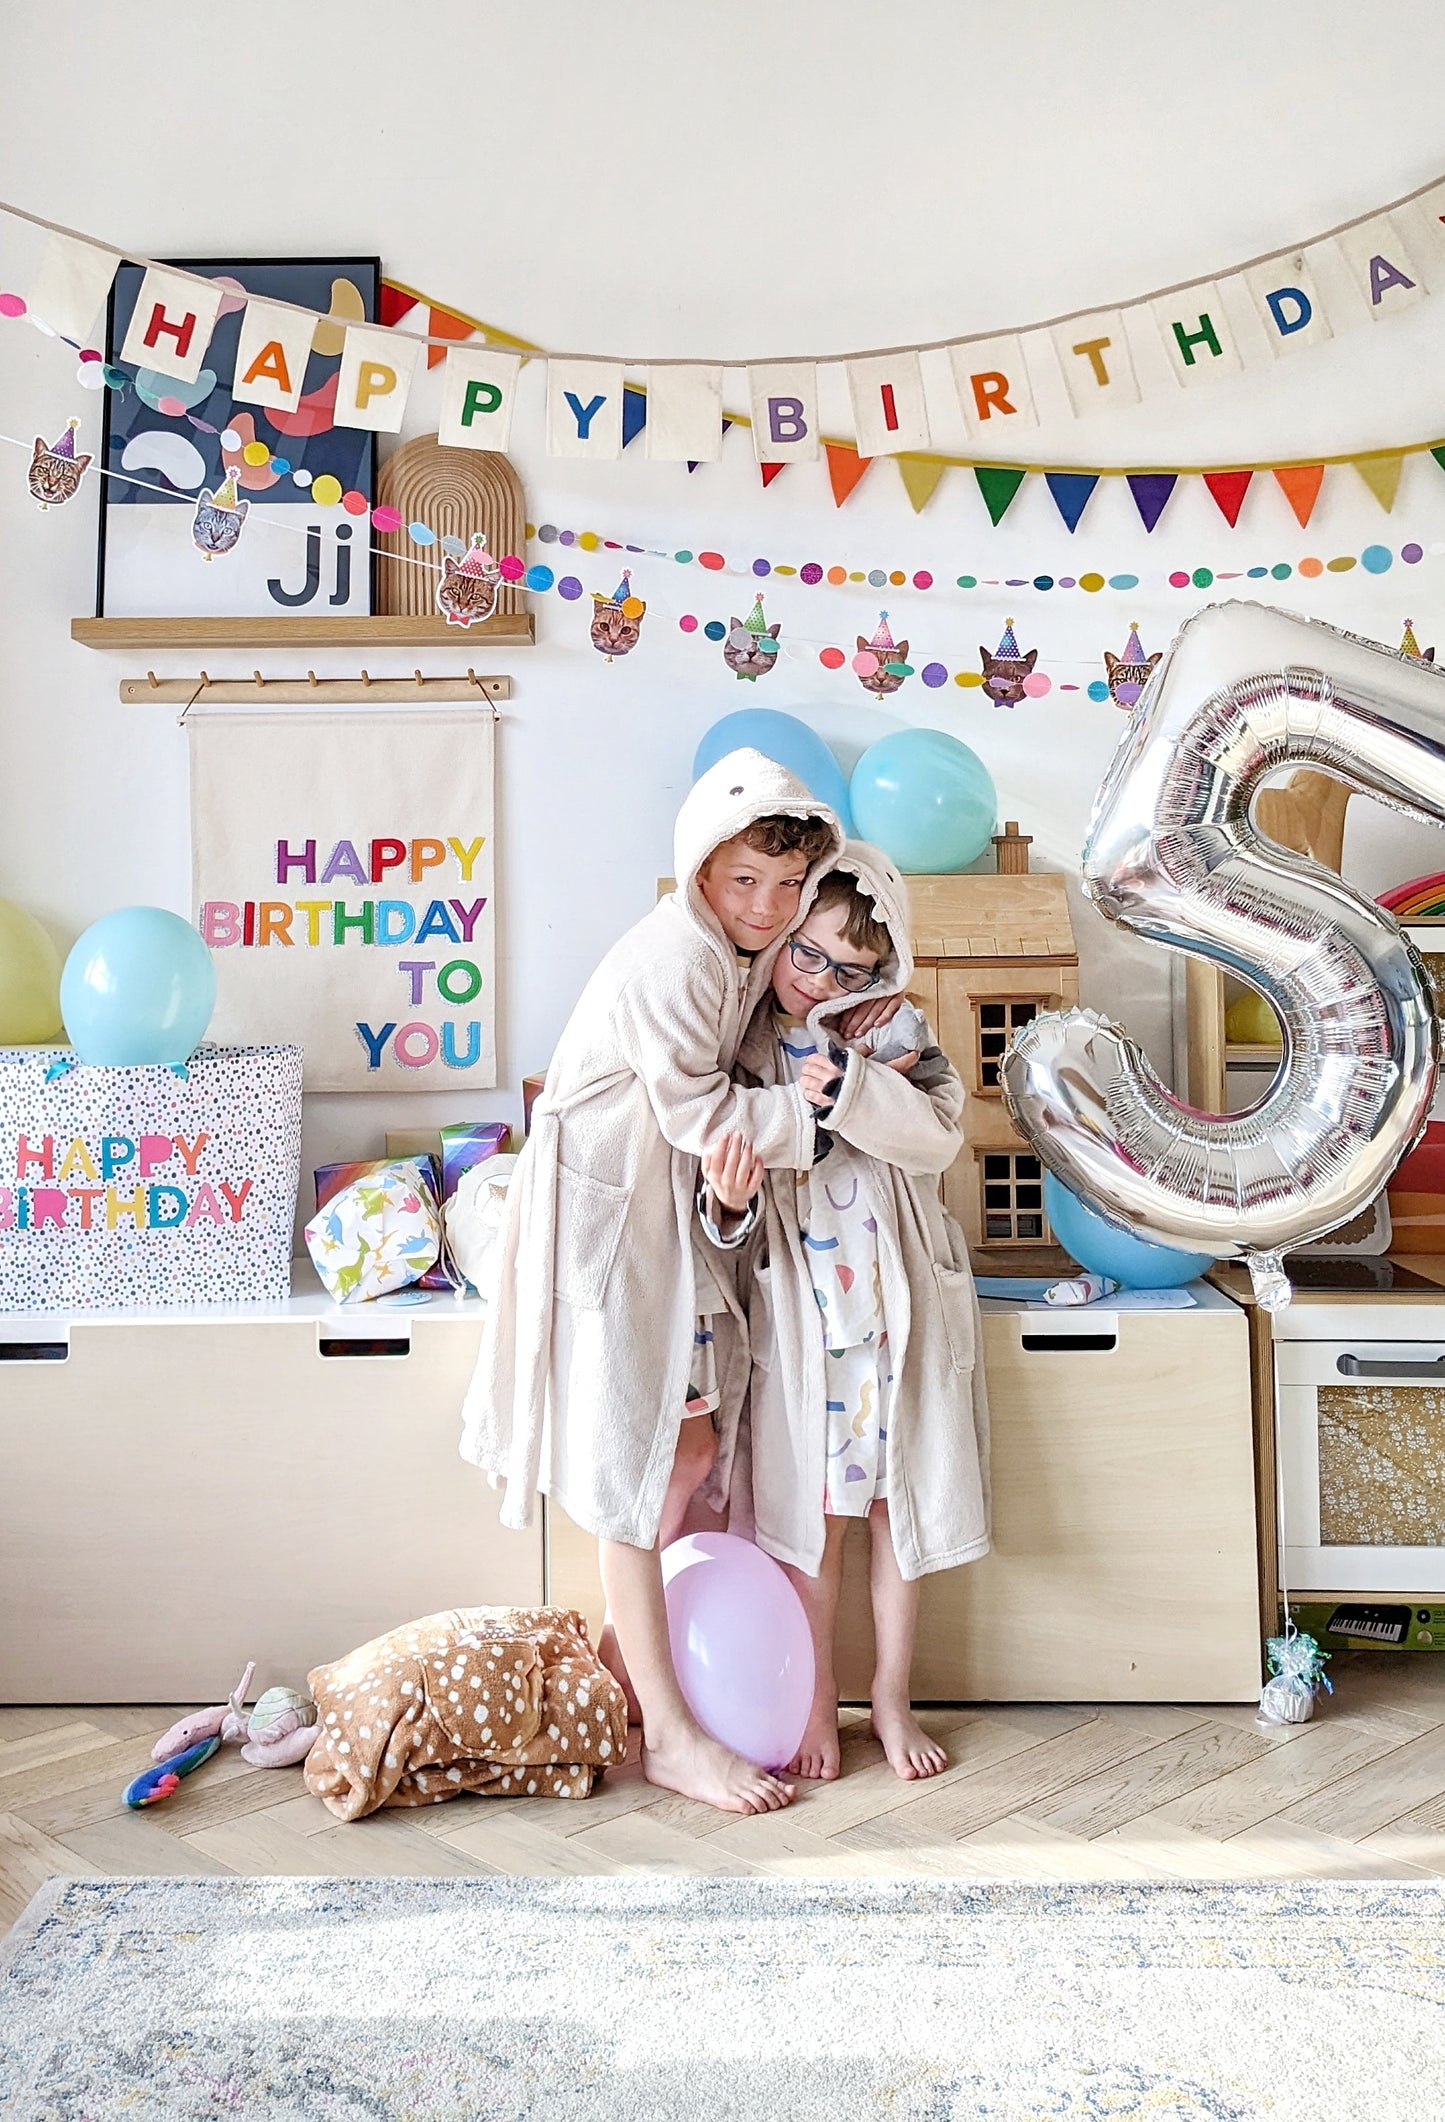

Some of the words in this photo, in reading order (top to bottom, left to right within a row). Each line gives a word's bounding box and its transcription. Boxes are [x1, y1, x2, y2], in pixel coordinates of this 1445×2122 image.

[143, 303, 607, 440] HAPPY
[768, 214, 1445, 443] BIRTHDA
[267, 523, 352, 607] Jj
[275, 837, 486, 885] HAPPY
[202, 897, 488, 946] BIRTHDAY
[999, 600, 1445, 1256] 5
[398, 959, 483, 1006] TO
[356, 1021, 481, 1070] YOU
[16, 1132, 212, 1181] HAPPY
